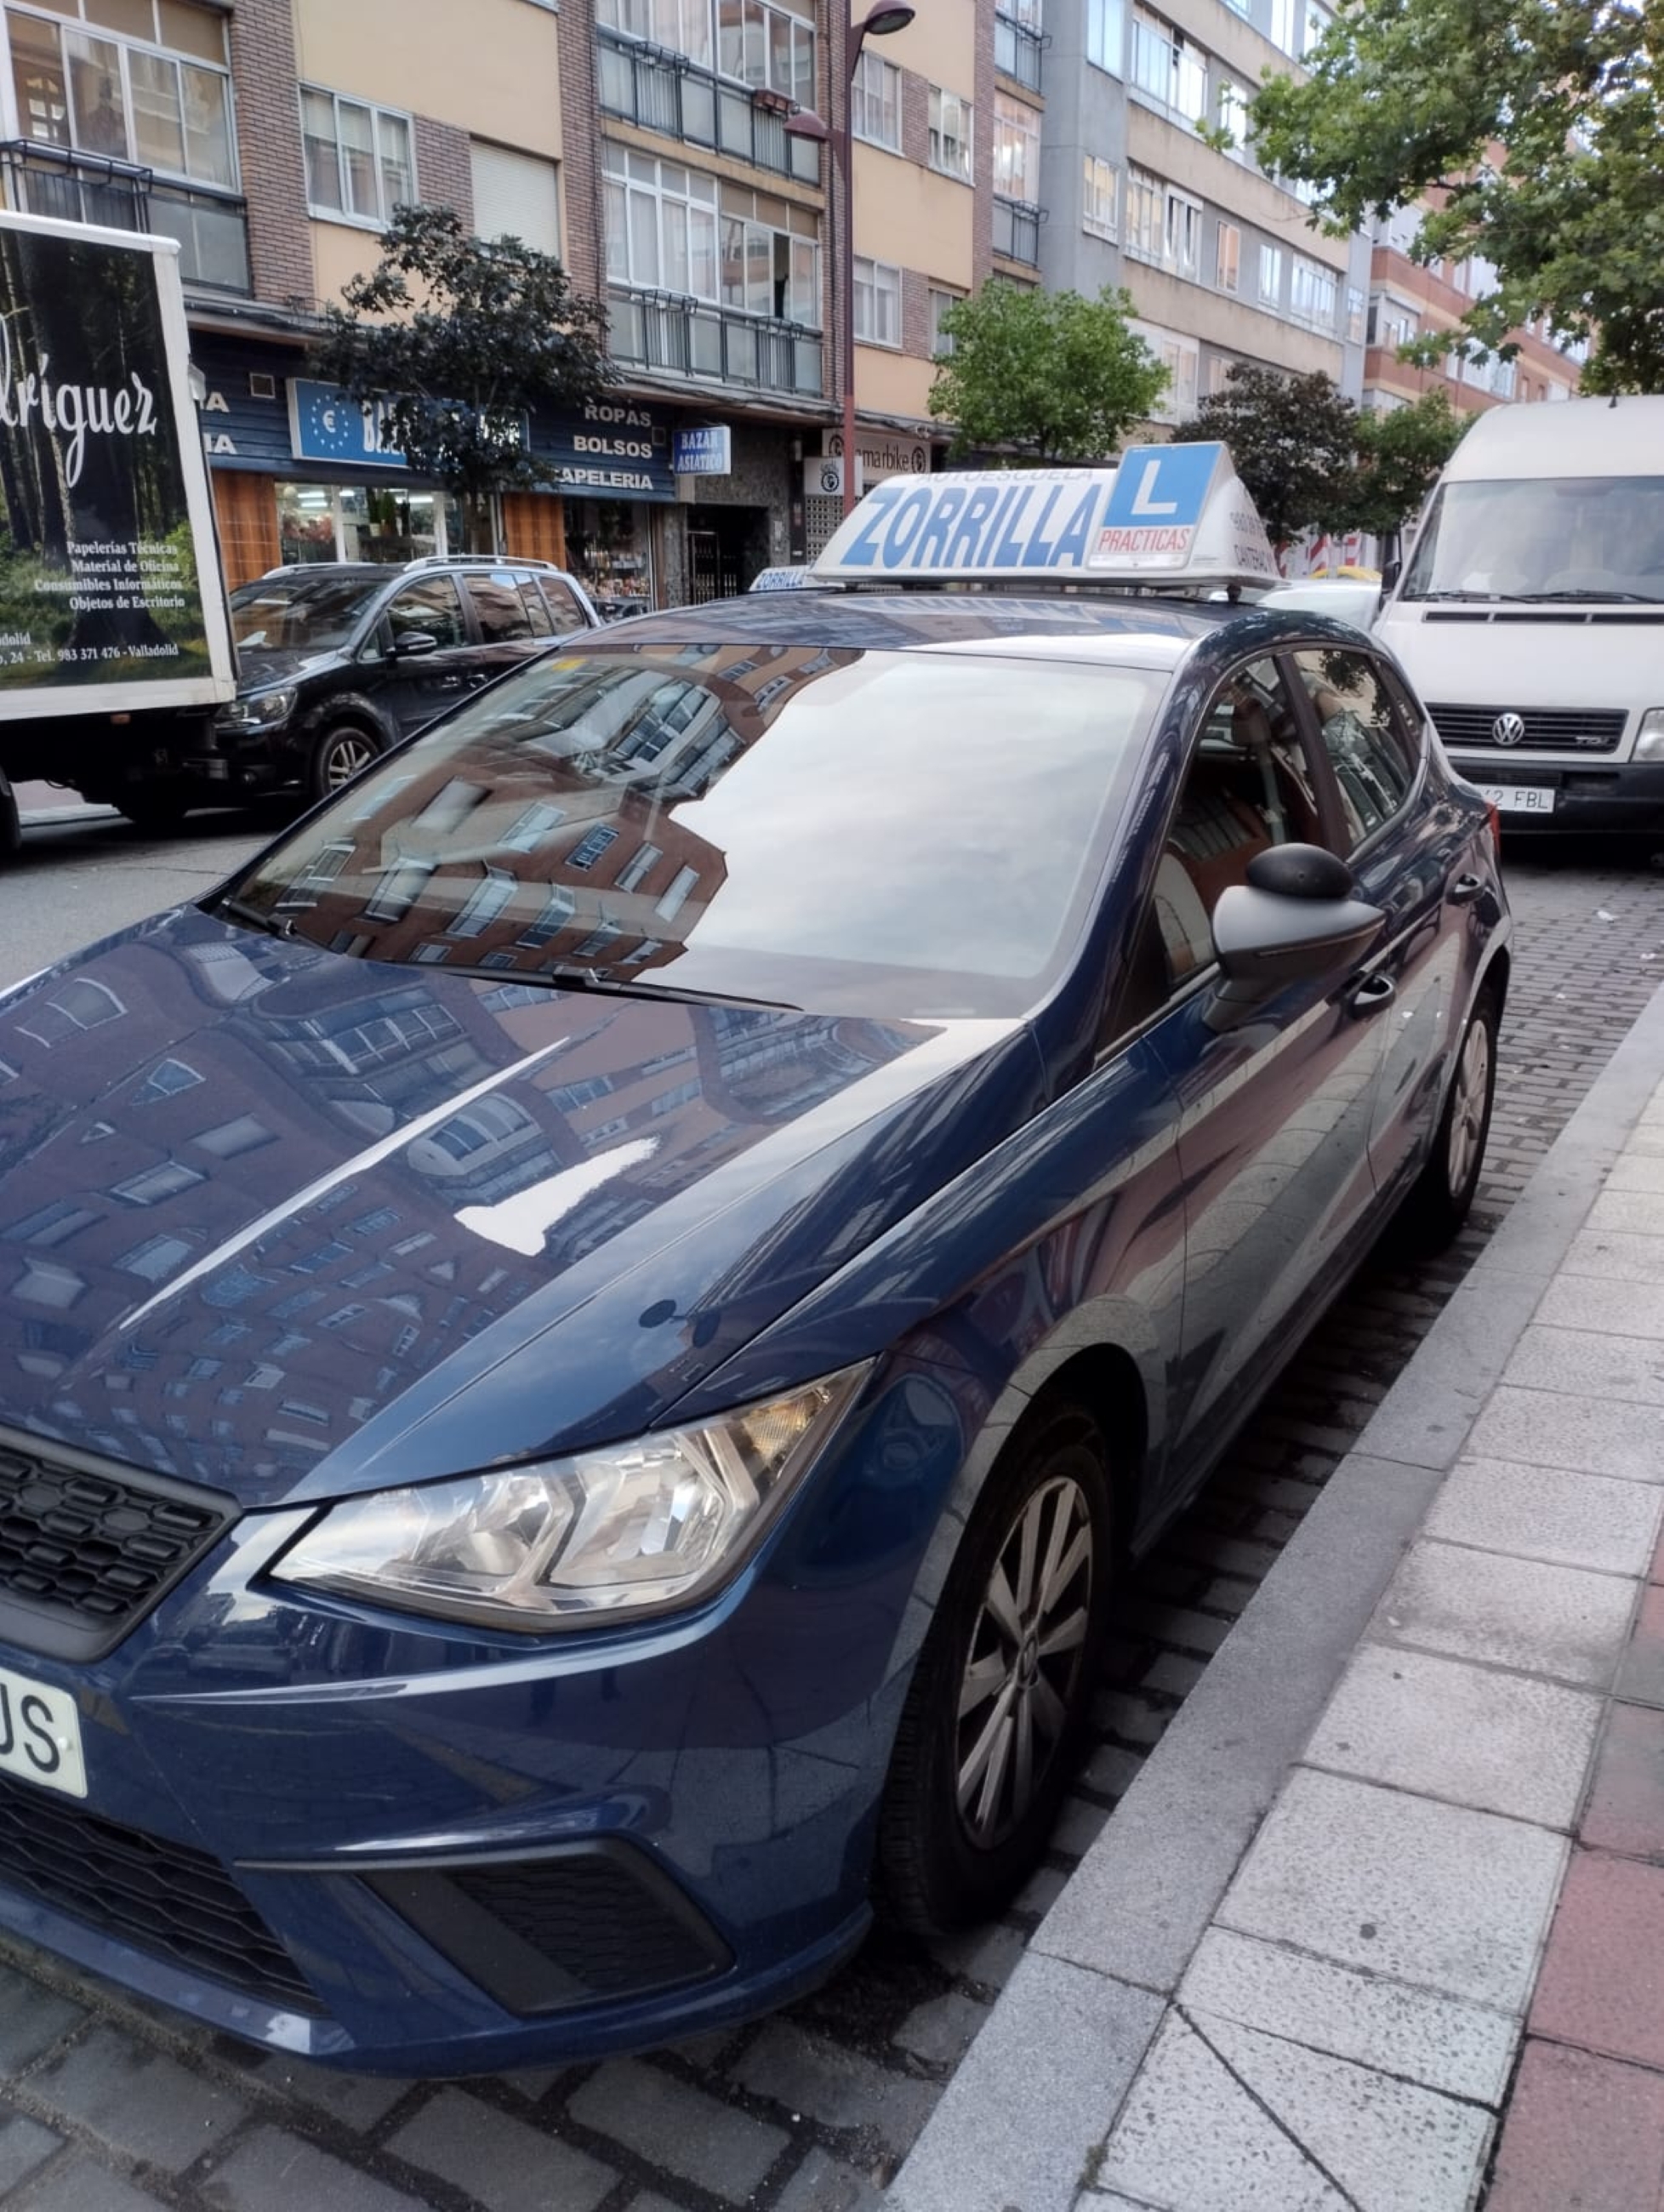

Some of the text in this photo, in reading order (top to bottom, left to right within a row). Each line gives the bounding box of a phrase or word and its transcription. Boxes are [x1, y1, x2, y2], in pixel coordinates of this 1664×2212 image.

[584, 404, 652, 426] ROPAS
[573, 435, 652, 459] BOLSOS
[681, 430, 717, 450] BAZAR
[677, 453, 723, 472] ASIATICO
[1131, 459, 1178, 515] L
[840, 484, 1103, 569] ZORRILLA
[1098, 528, 1189, 551] PRACTICAS
[71, 560, 180, 573] Material de Oficina
[34, 579, 111, 592] Consumibles
[70, 595, 185, 612] Objetos de Escritorio
[0, 631, 31, 646] dolid
[10, 652, 24, 664] 24
[34, 649, 55, 663] Tel.
[57, 647, 77, 661] 983
[81, 647, 98, 660] 371
[101, 647, 121, 658] 476
[128, 643, 179, 658] Valladolid
[1513, 791, 1548, 809] FBL
